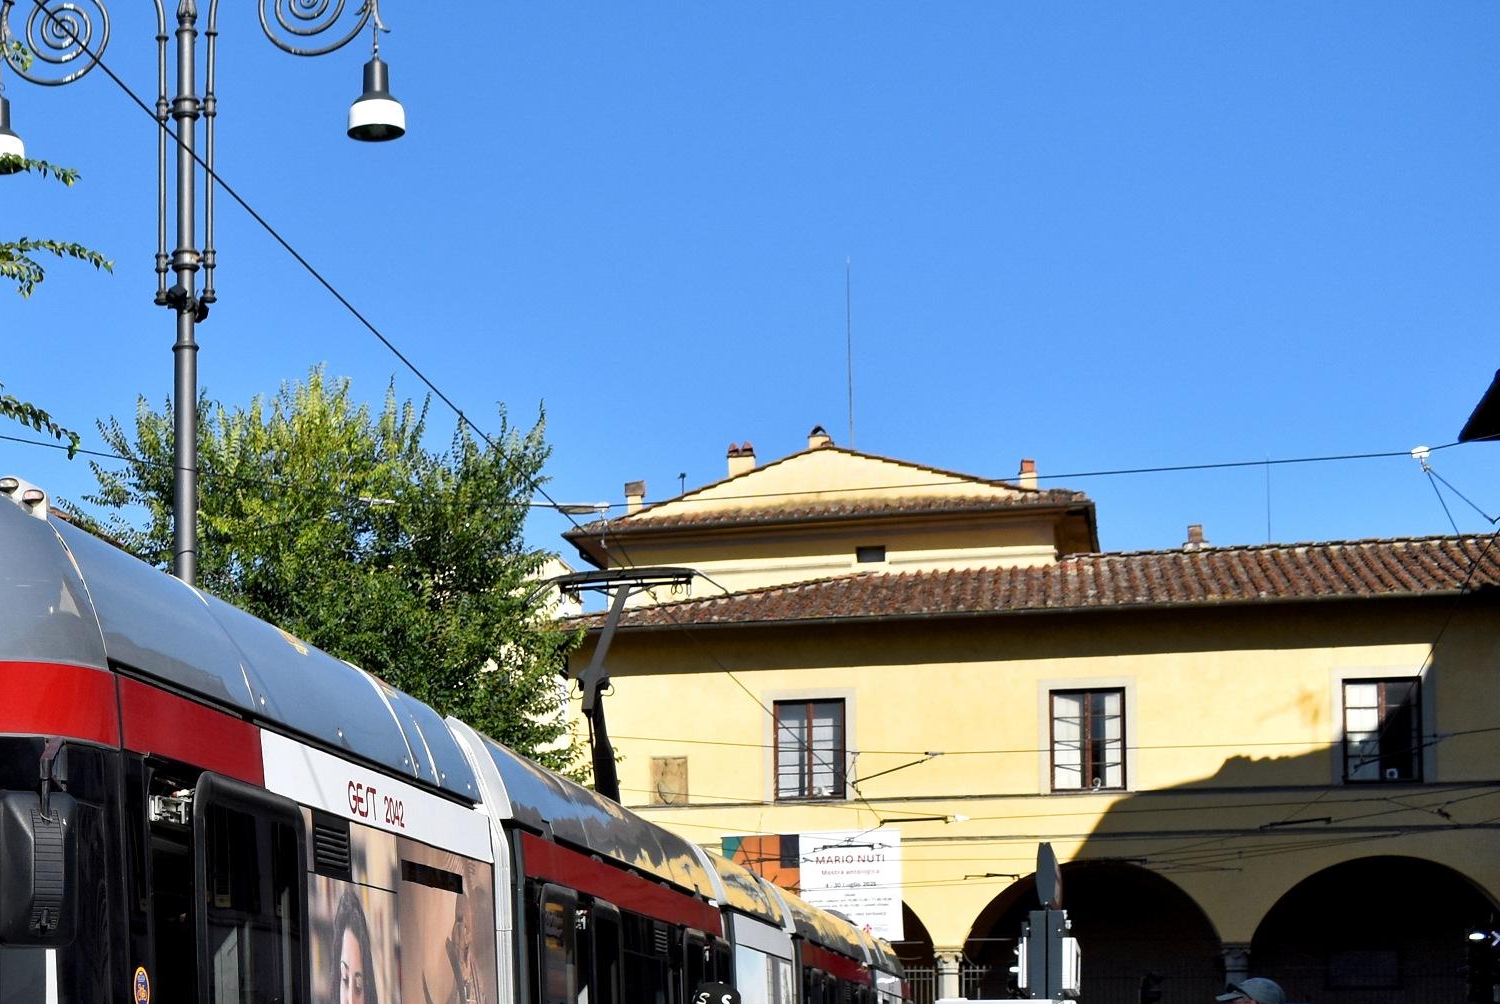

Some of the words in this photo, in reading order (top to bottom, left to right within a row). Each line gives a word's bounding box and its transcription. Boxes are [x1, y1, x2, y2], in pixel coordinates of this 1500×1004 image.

[347, 780, 377, 821] GEST
[384, 795, 405, 828] 2042
[815, 855, 854, 864] MARIO
[857, 854, 885, 863] NUTI
